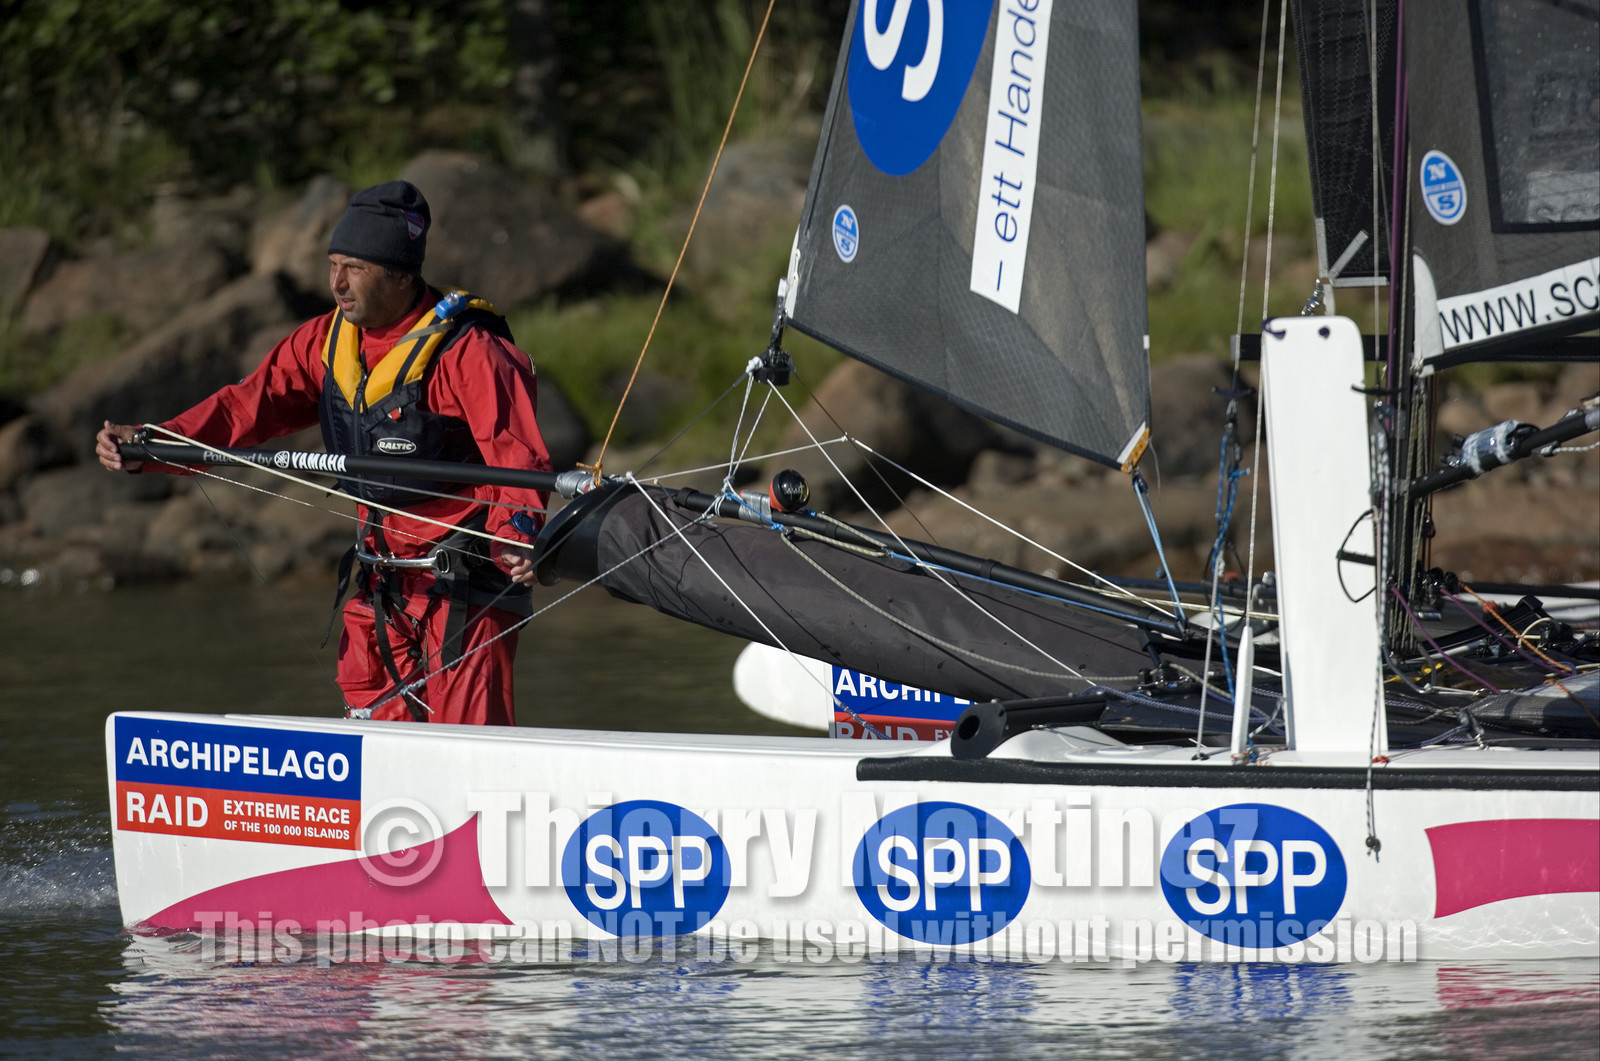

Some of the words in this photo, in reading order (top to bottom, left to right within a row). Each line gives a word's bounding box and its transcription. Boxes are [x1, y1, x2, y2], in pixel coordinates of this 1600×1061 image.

[991, 171, 1023, 243] ett
[258, 453, 273, 467] by
[291, 451, 347, 473] YAMAHA
[379, 441, 412, 450] BALTIC
[126, 736, 350, 782] ARCHIPELAGO
[126, 791, 209, 828] RAID
[223, 799, 301, 821] EXTREME
[304, 806, 350, 825] RACE
[224, 819, 238, 830] OF
[241, 821, 261, 833] THE
[263, 823, 281, 835] 100
[283, 825, 301, 837] 000
[304, 828, 350, 840] ISLANDS
[585, 833, 713, 910] SPP
[876, 835, 1012, 912] SPP
[1185, 837, 1328, 915] SPP
